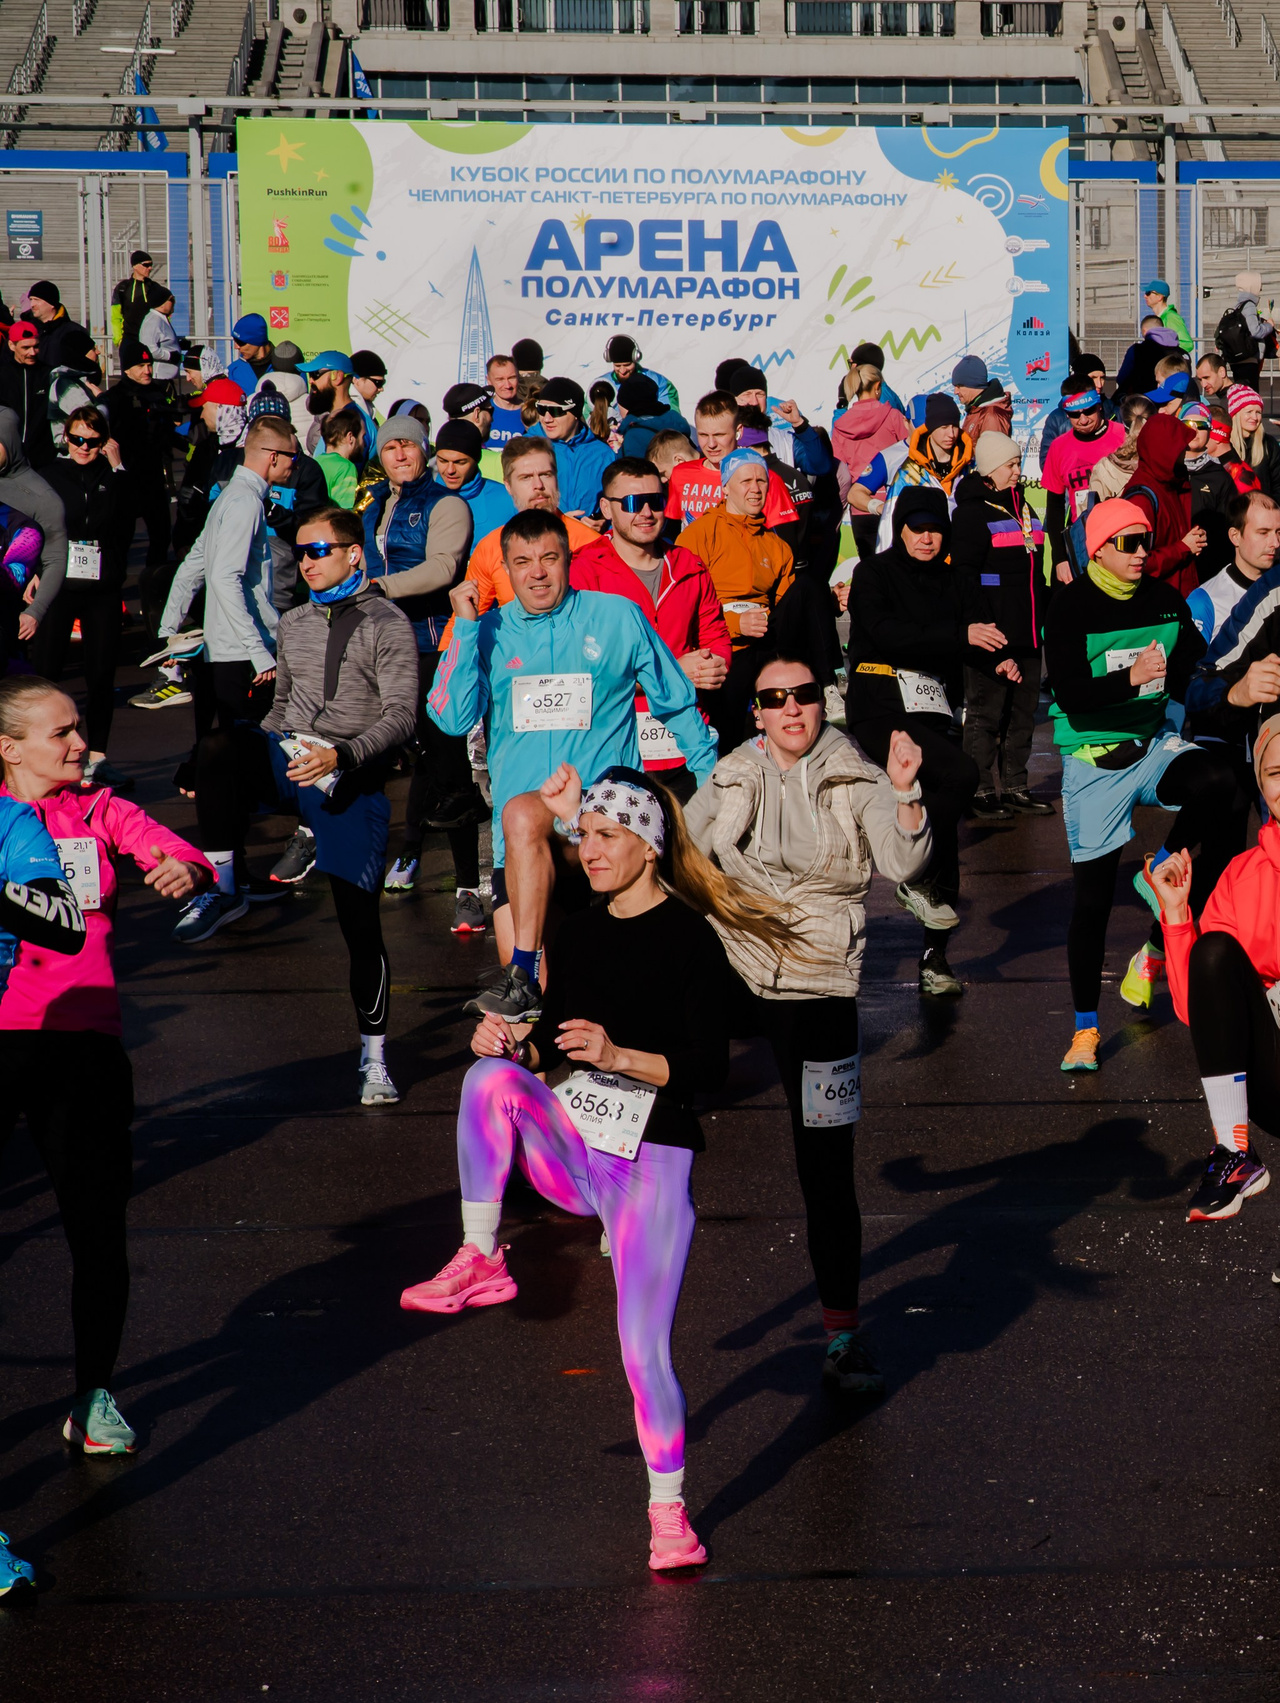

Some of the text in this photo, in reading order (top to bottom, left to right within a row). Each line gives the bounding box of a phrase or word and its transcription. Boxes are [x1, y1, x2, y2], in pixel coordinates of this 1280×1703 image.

[450, 166, 867, 186] КУБОК РОССИИ ПО ПОЛУМАРАФОНУ
[267, 187, 328, 198] PushkinRun
[408, 189, 908, 206] ЧЕМПИОНАТ САНКТ-ПЕТЕРБУРГА ПО ПОЛУМАРАФОНУ
[524, 218, 798, 272] АРЕНА
[521, 275, 800, 300] ПОЛУМАРАФОН
[545, 308, 778, 332] Санкт-Петербург
[1065, 395, 1093, 408] RUSSIA
[682, 483, 728, 498] SAMA
[915, 684, 942, 697] 6895
[73, 842, 88, 850] 21,1
[84, 866, 91, 875] B
[831, 1060, 856, 1073] АРЕНА
[588, 1073, 619, 1087] АРЕНА
[631, 1084, 647, 1097] 21,1
[570, 1090, 624, 1121] 6563
[839, 1097, 855, 1106] ВЕРА
[580, 1113, 603, 1125] ЮЛИЯ
[631, 1113, 639, 1123] B
